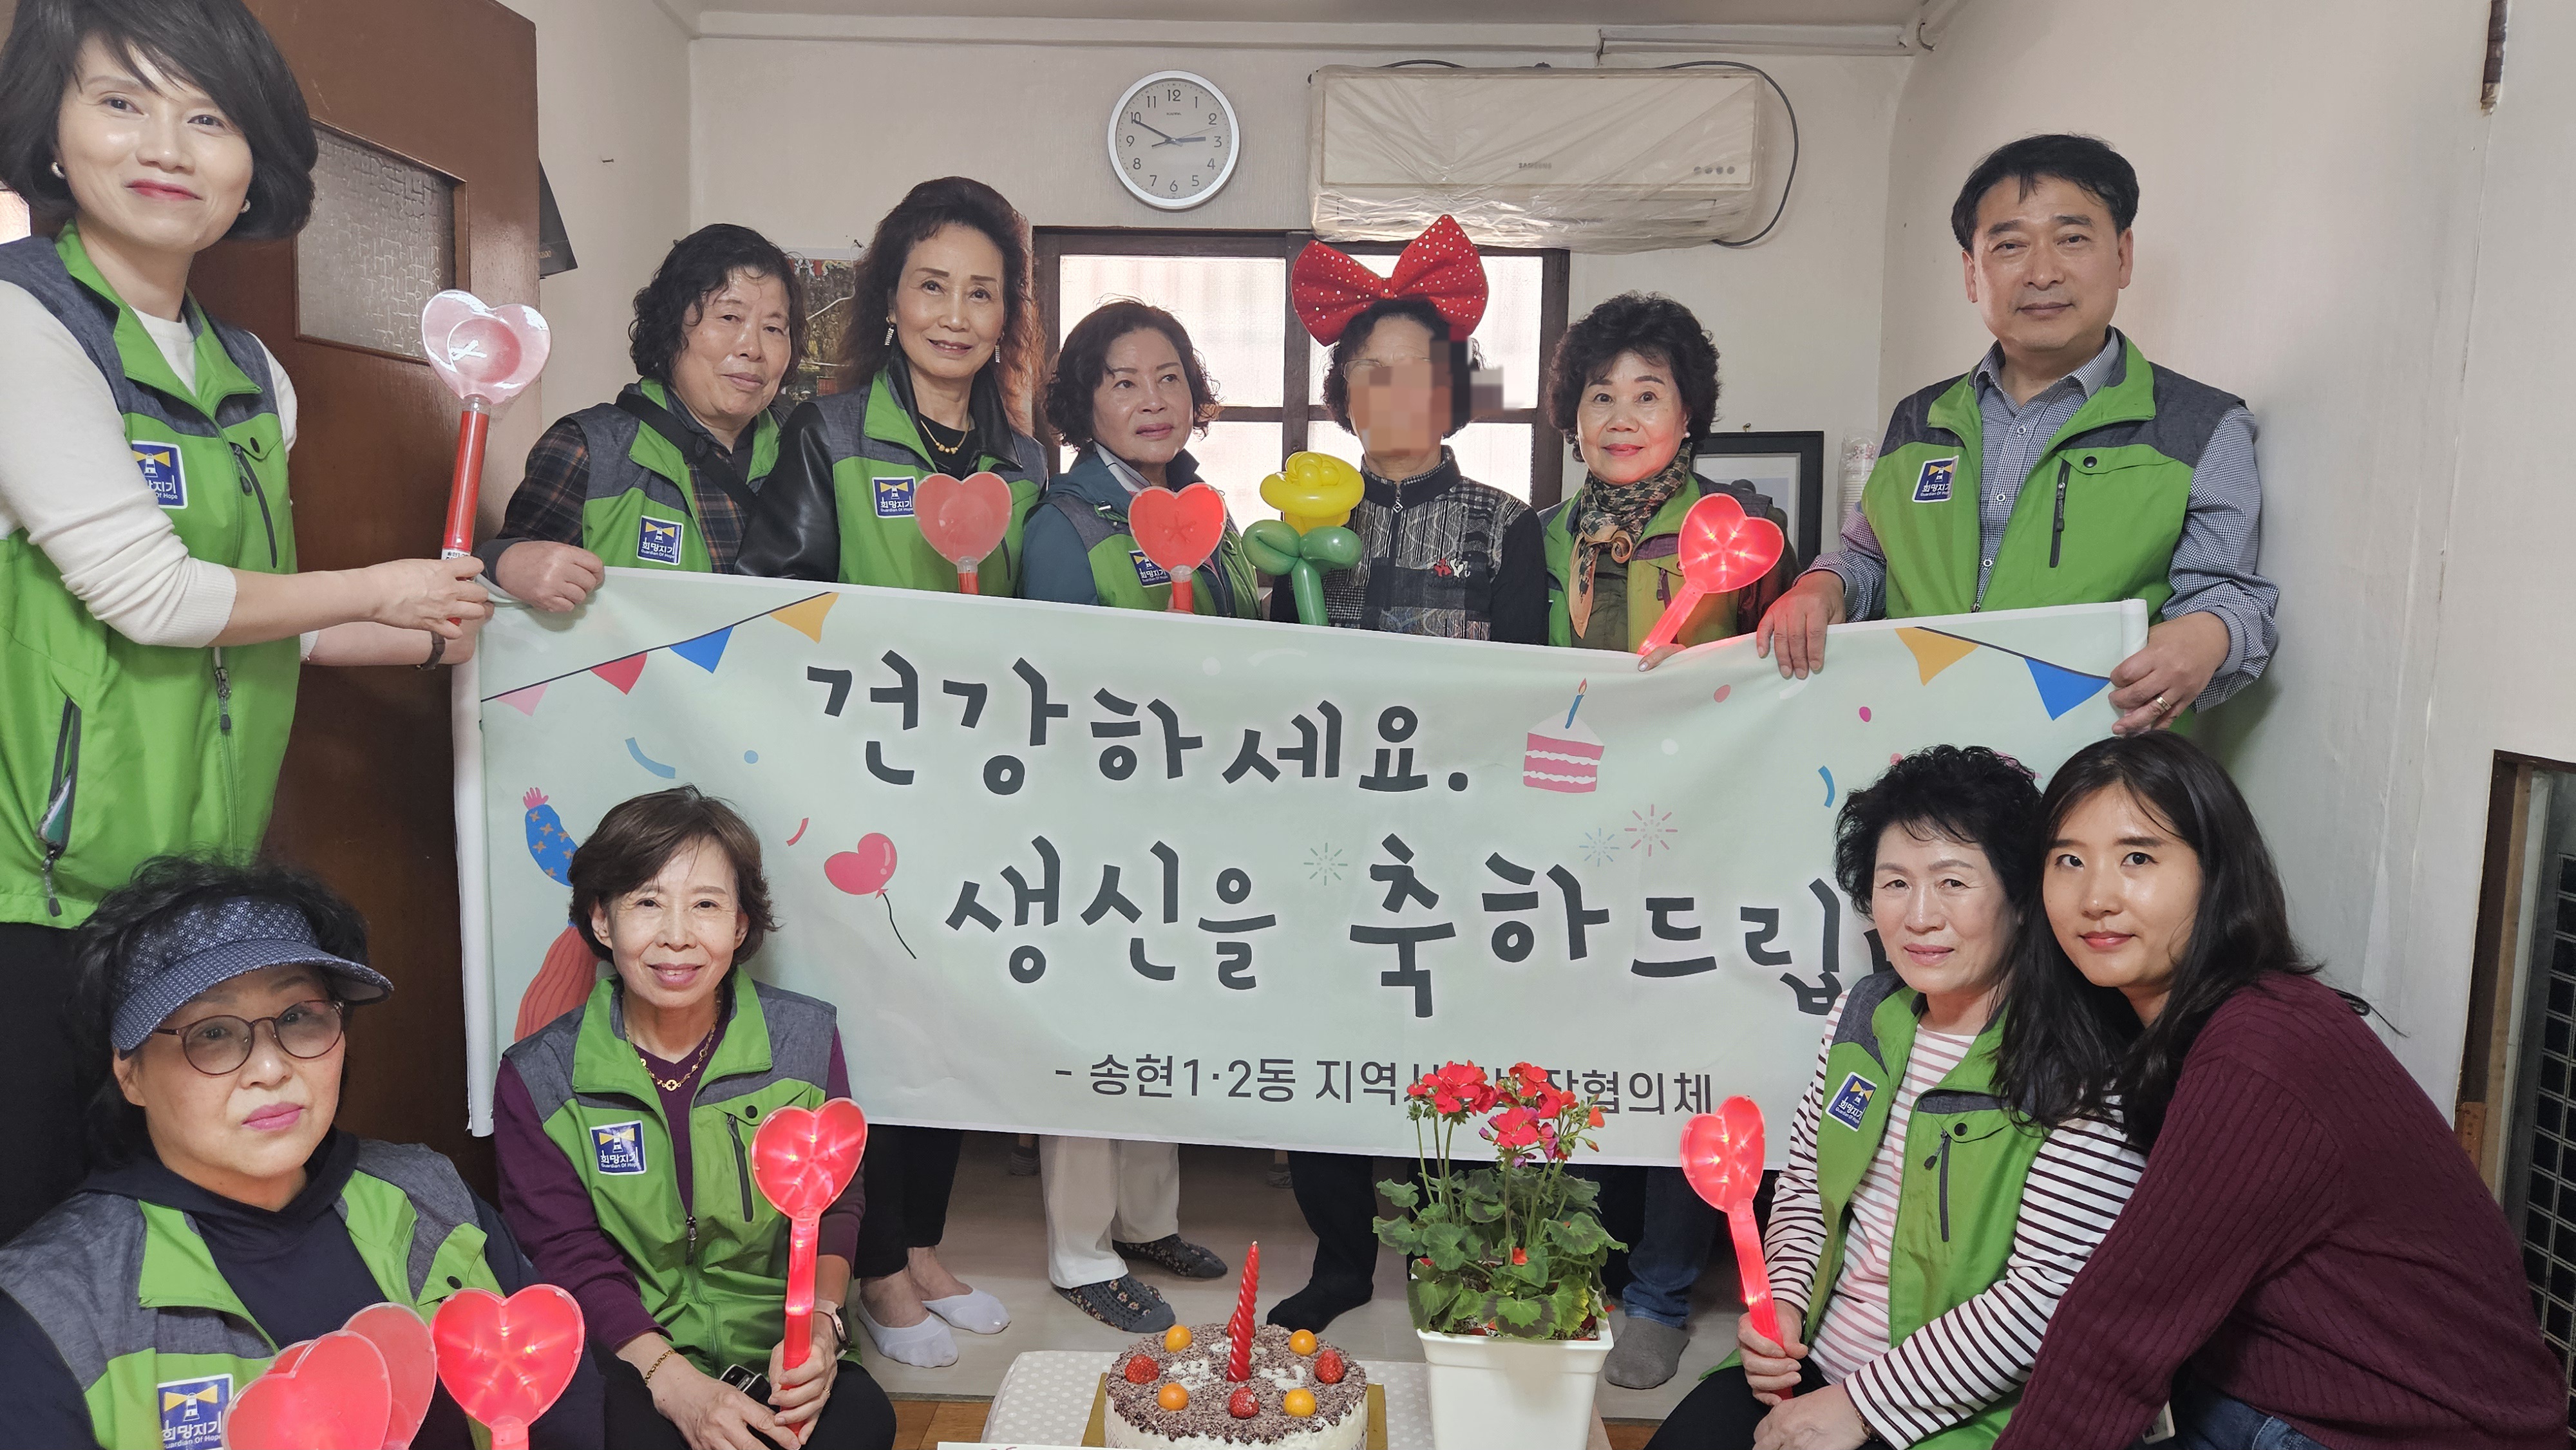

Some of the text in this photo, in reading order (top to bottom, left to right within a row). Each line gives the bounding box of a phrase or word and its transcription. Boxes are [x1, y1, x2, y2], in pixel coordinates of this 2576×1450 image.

[1147, 96, 1156, 108] 11
[1168, 89, 1181, 102] 12
[1131, 111, 1141, 124] 10
[1208, 113, 1217, 125] 2
[1126, 135, 1135, 147] 9
[1214, 136, 1222, 147] 3
[1133, 158, 1141, 170] 8
[1207, 158, 1215, 170] 4
[1150, 174, 1157, 187] 7
[1170, 180, 1178, 192] 6
[1192, 174, 1199, 187] 5
[149, 475, 176, 494] 지기
[880, 495, 912, 508] 희망지기
[641, 537, 675, 555] 희망지기
[1139, 568, 1166, 579] 희망지기
[807, 649, 1469, 795] 건강하세요.
[945, 834, 1276, 990] 생신을
[1090, 1053, 1296, 1103] 송현1·2동
[1838, 1096, 1866, 1120] 희망지기
[600, 1146, 639, 1164] 희망지기
[162, 1411, 221, 1442] 희망지기
[161, 1439, 193, 1449] uardian
